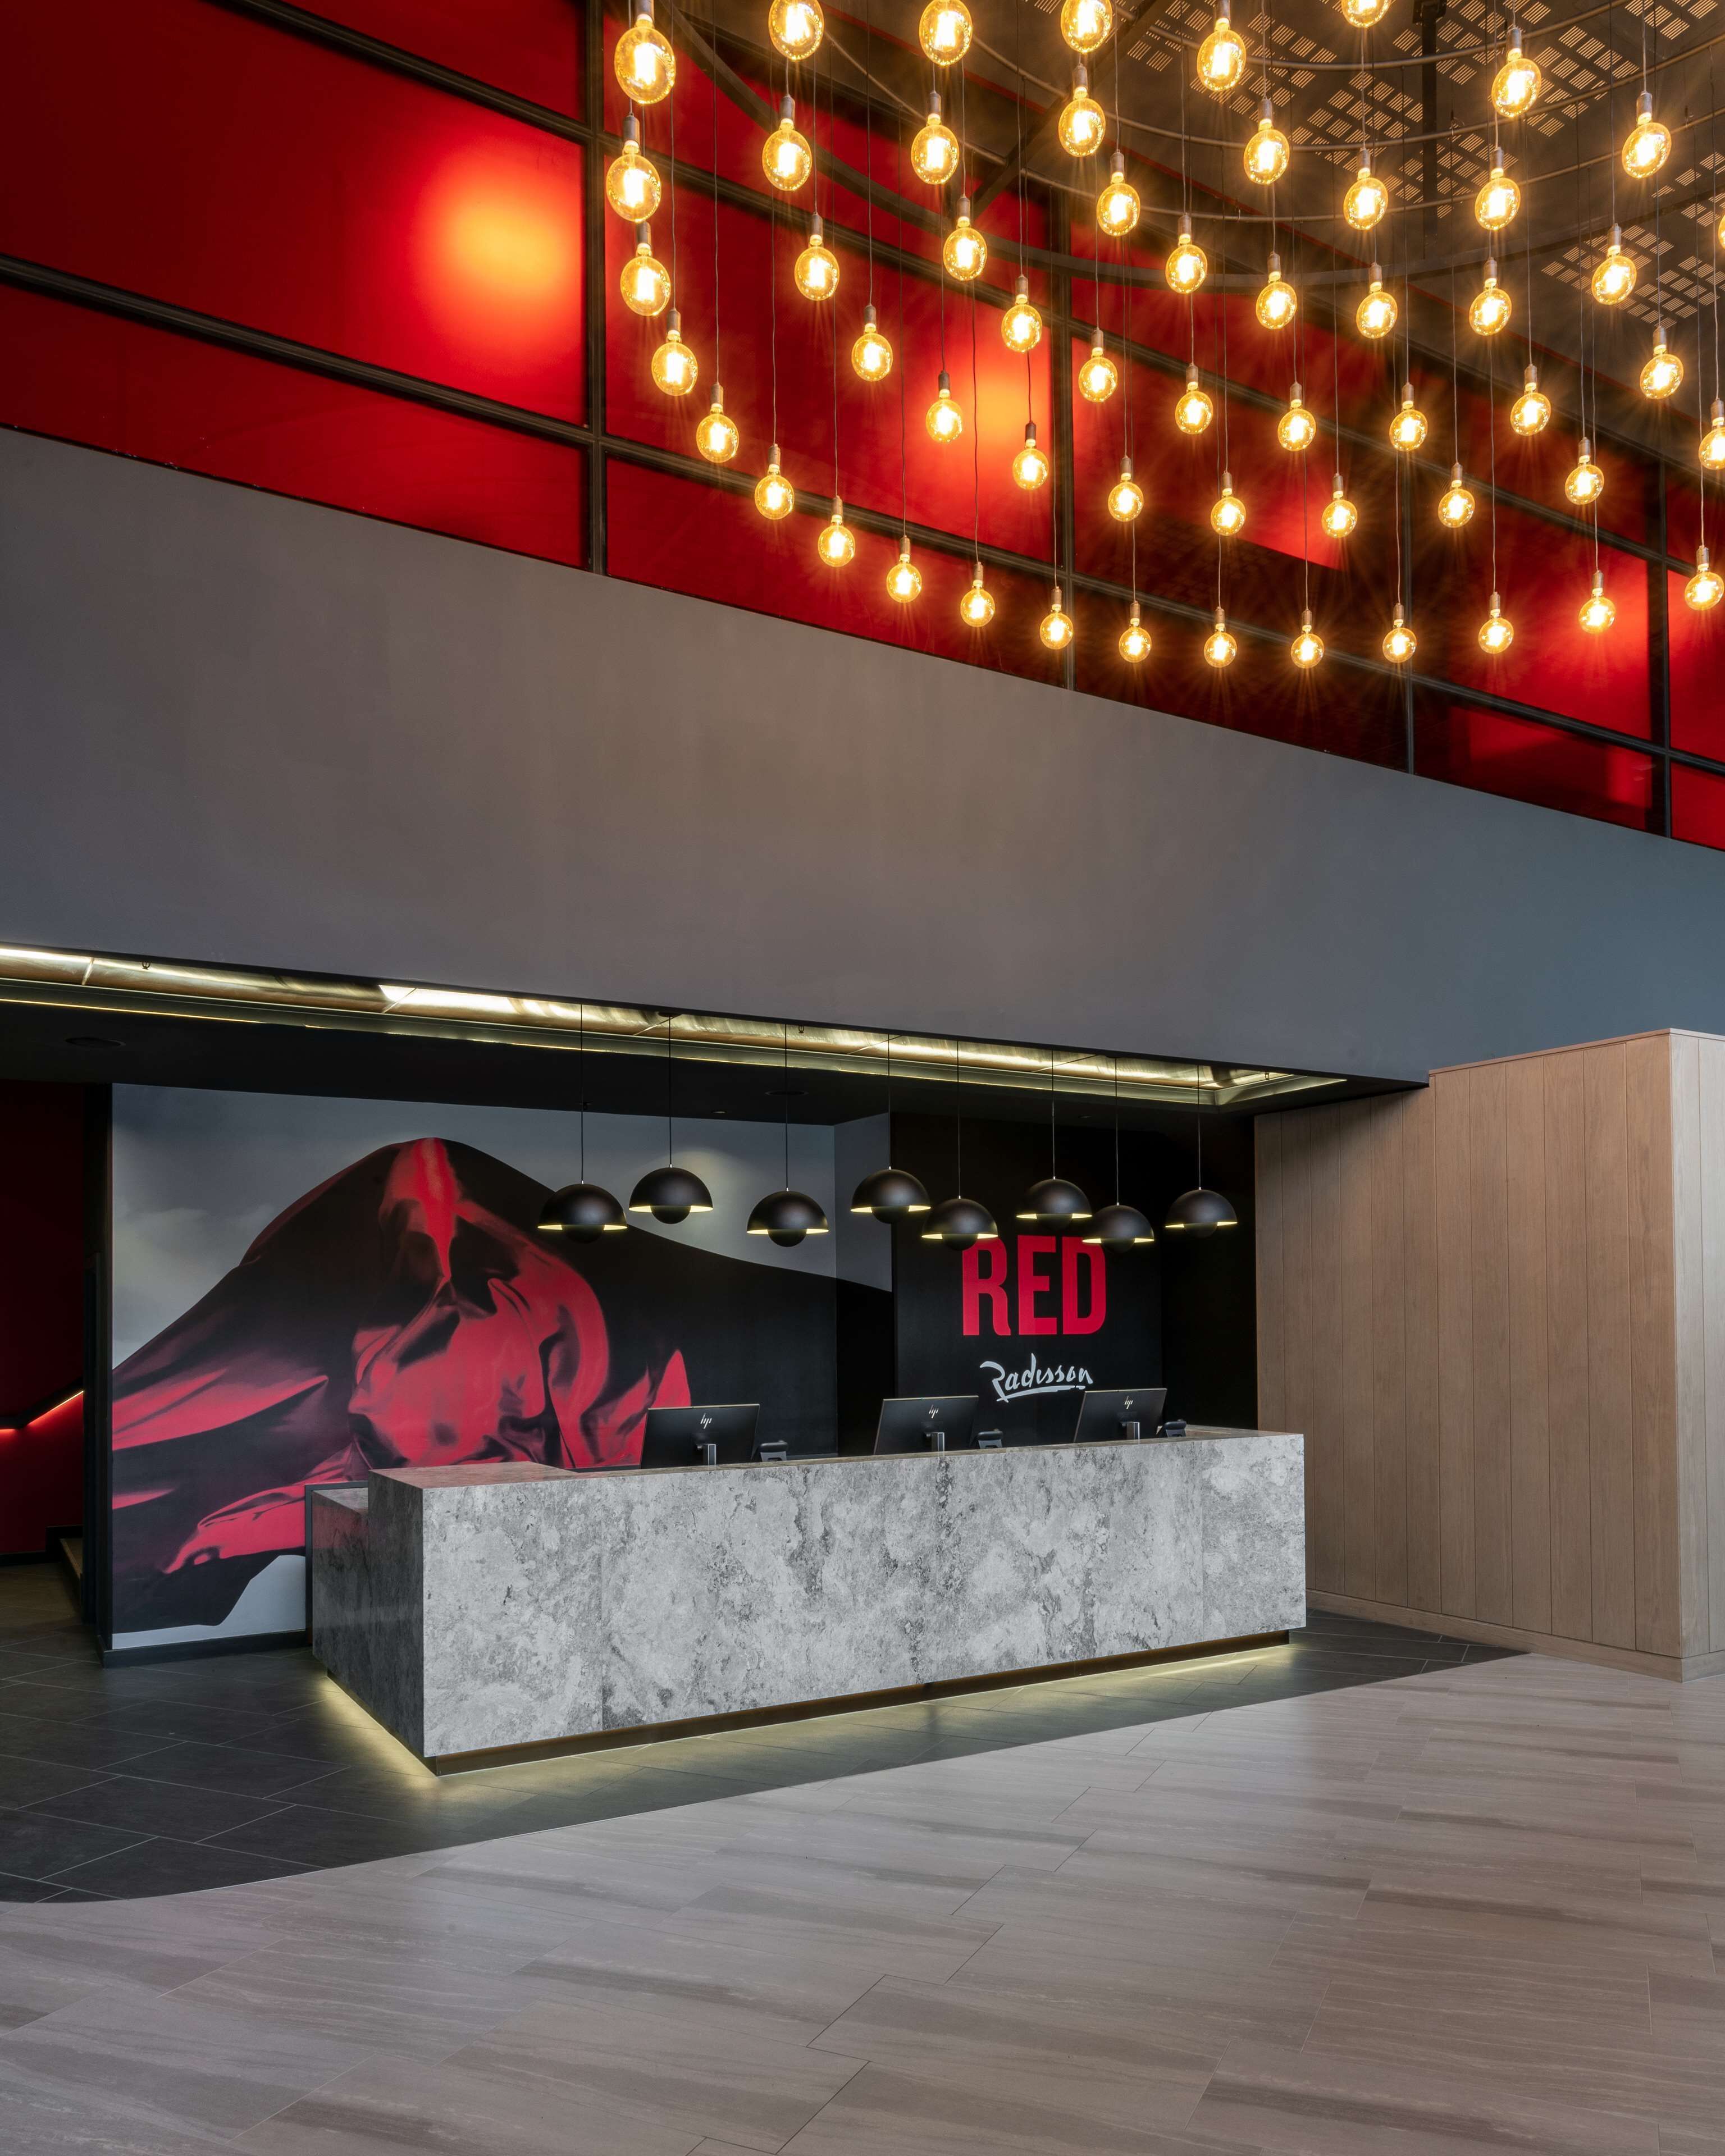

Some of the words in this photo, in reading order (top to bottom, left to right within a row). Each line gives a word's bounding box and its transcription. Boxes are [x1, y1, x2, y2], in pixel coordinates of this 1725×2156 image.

[962, 1235, 1107, 1336] RED
[980, 1353, 1093, 1403] Radisson
[1124, 1395, 1133, 1409] hp
[700, 1412, 712, 1429] hp
